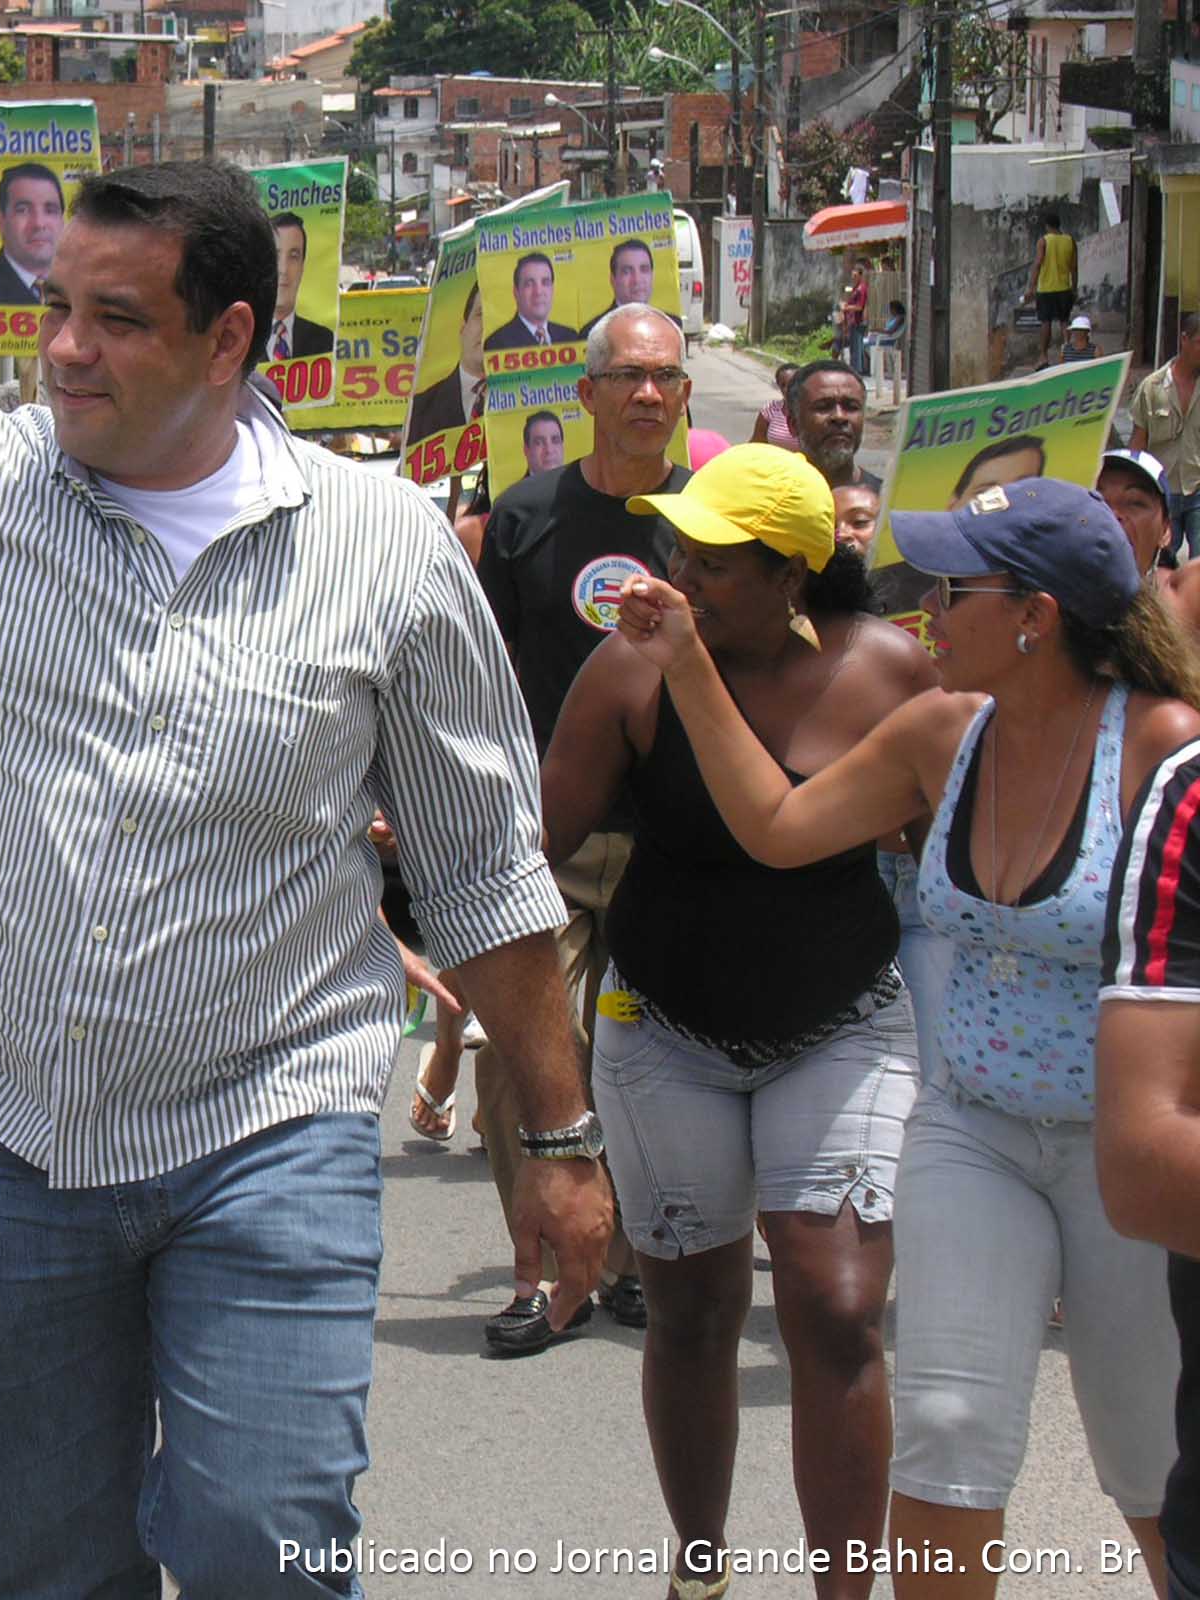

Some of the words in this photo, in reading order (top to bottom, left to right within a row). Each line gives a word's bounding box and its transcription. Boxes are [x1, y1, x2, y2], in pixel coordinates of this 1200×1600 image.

[268, 180, 342, 210] Sanches
[479, 231, 509, 252] Alan
[512, 224, 571, 249] Sanches
[574, 217, 604, 241] Alan
[608, 209, 672, 237] Sanches
[438, 248, 476, 284] Alan
[336, 337, 370, 360] an
[488, 346, 577, 373] 15600
[266, 357, 332, 404] 600
[488, 388, 516, 411] Alan
[520, 379, 579, 406] Sanches
[903, 415, 976, 450] Alan
[986, 386, 1115, 438] Sanches
[406, 424, 485, 485] 15.6
